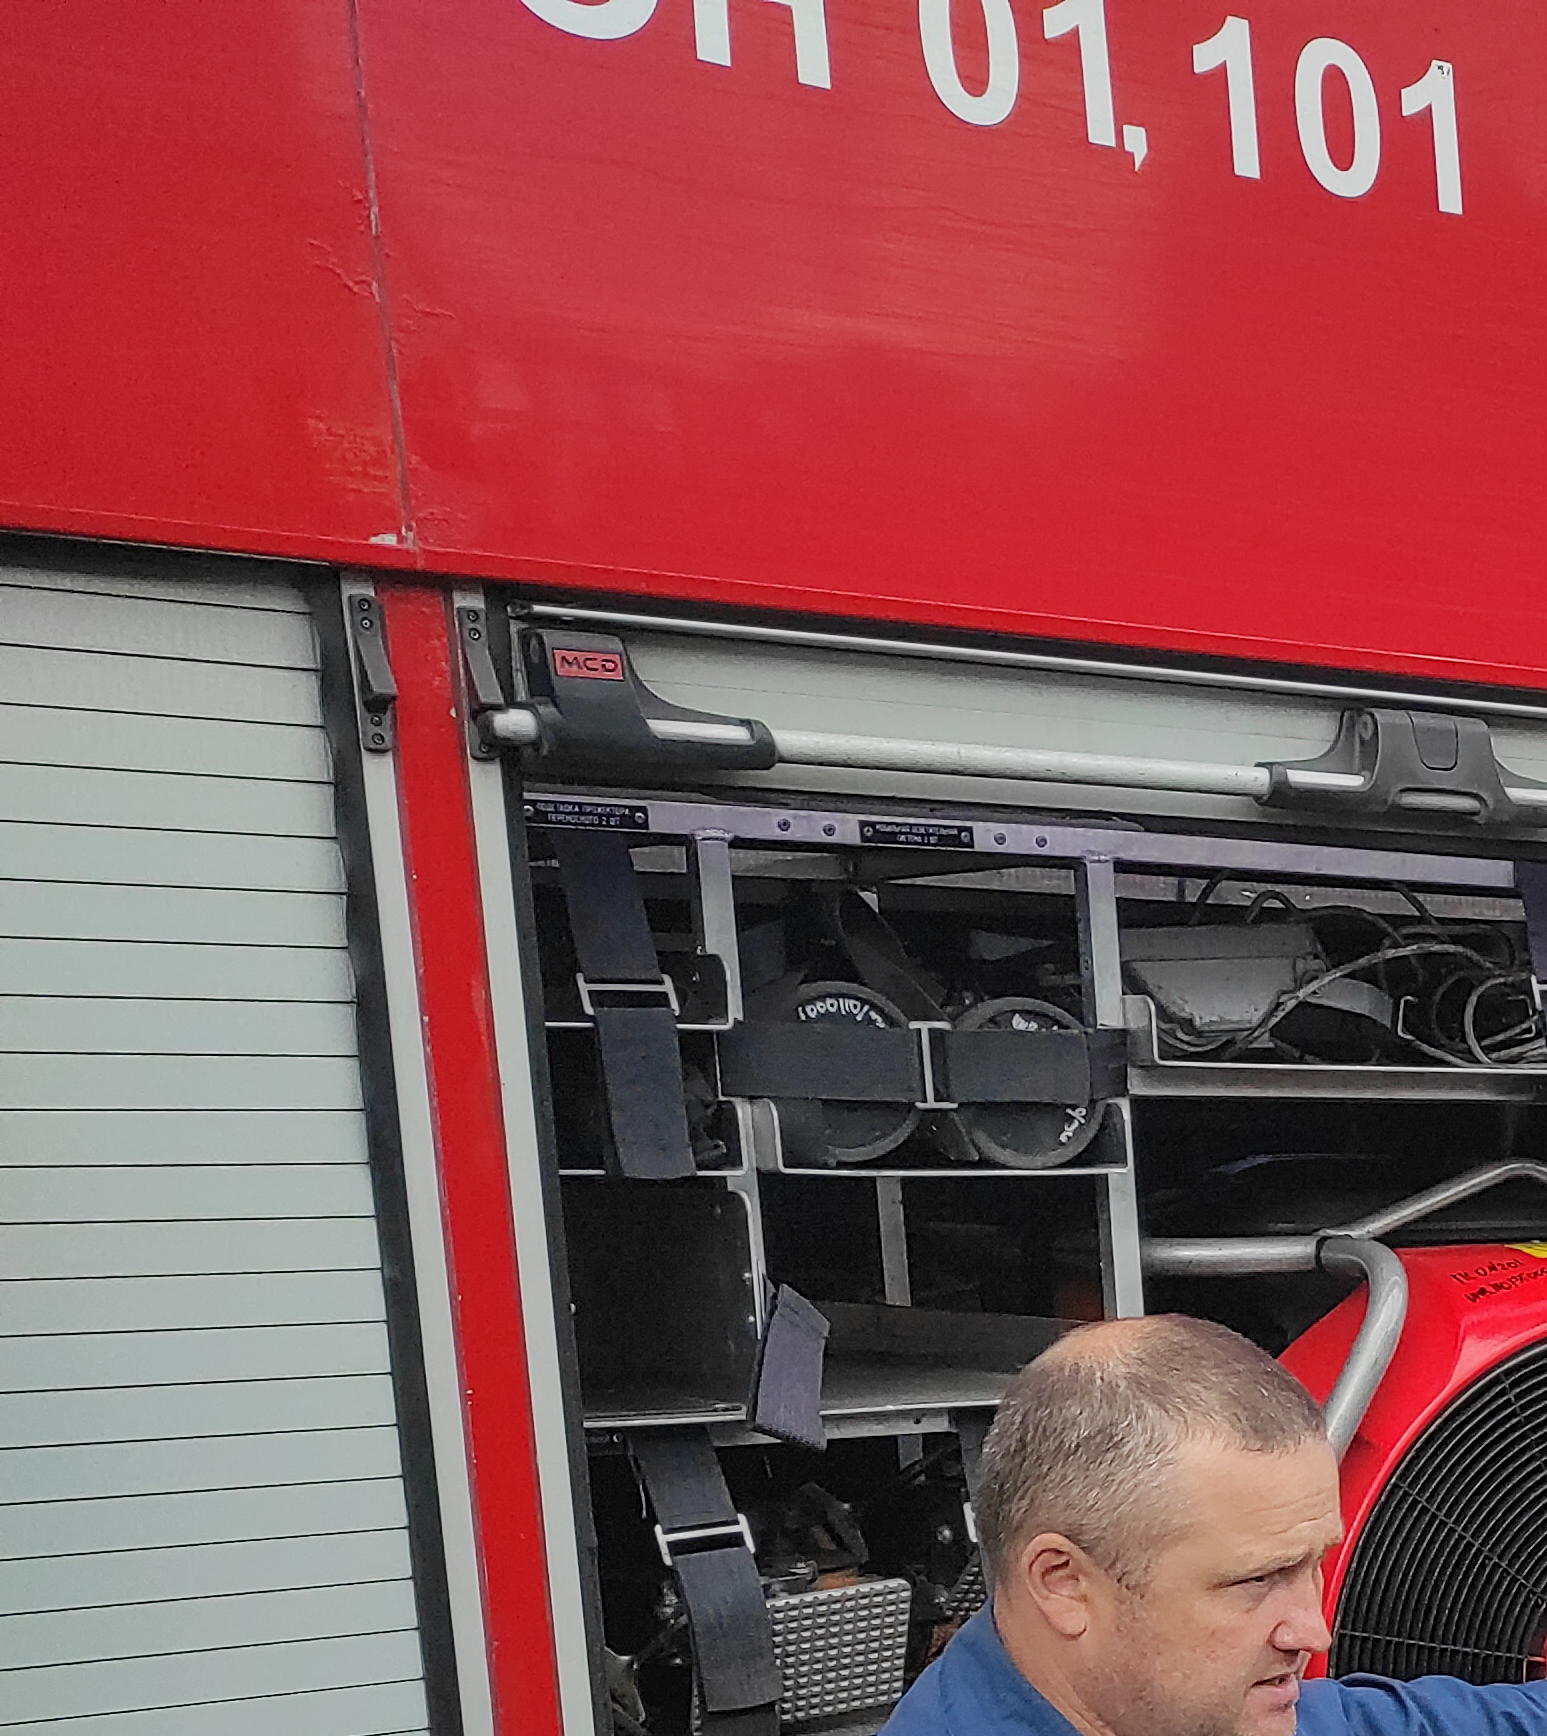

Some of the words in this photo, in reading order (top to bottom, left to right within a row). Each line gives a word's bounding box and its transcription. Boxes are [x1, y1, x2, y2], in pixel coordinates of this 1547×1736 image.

[918, 0, 1148, 172] 01,
[1193, 14, 1463, 215] 101
[561, 655, 618, 673] MCD
